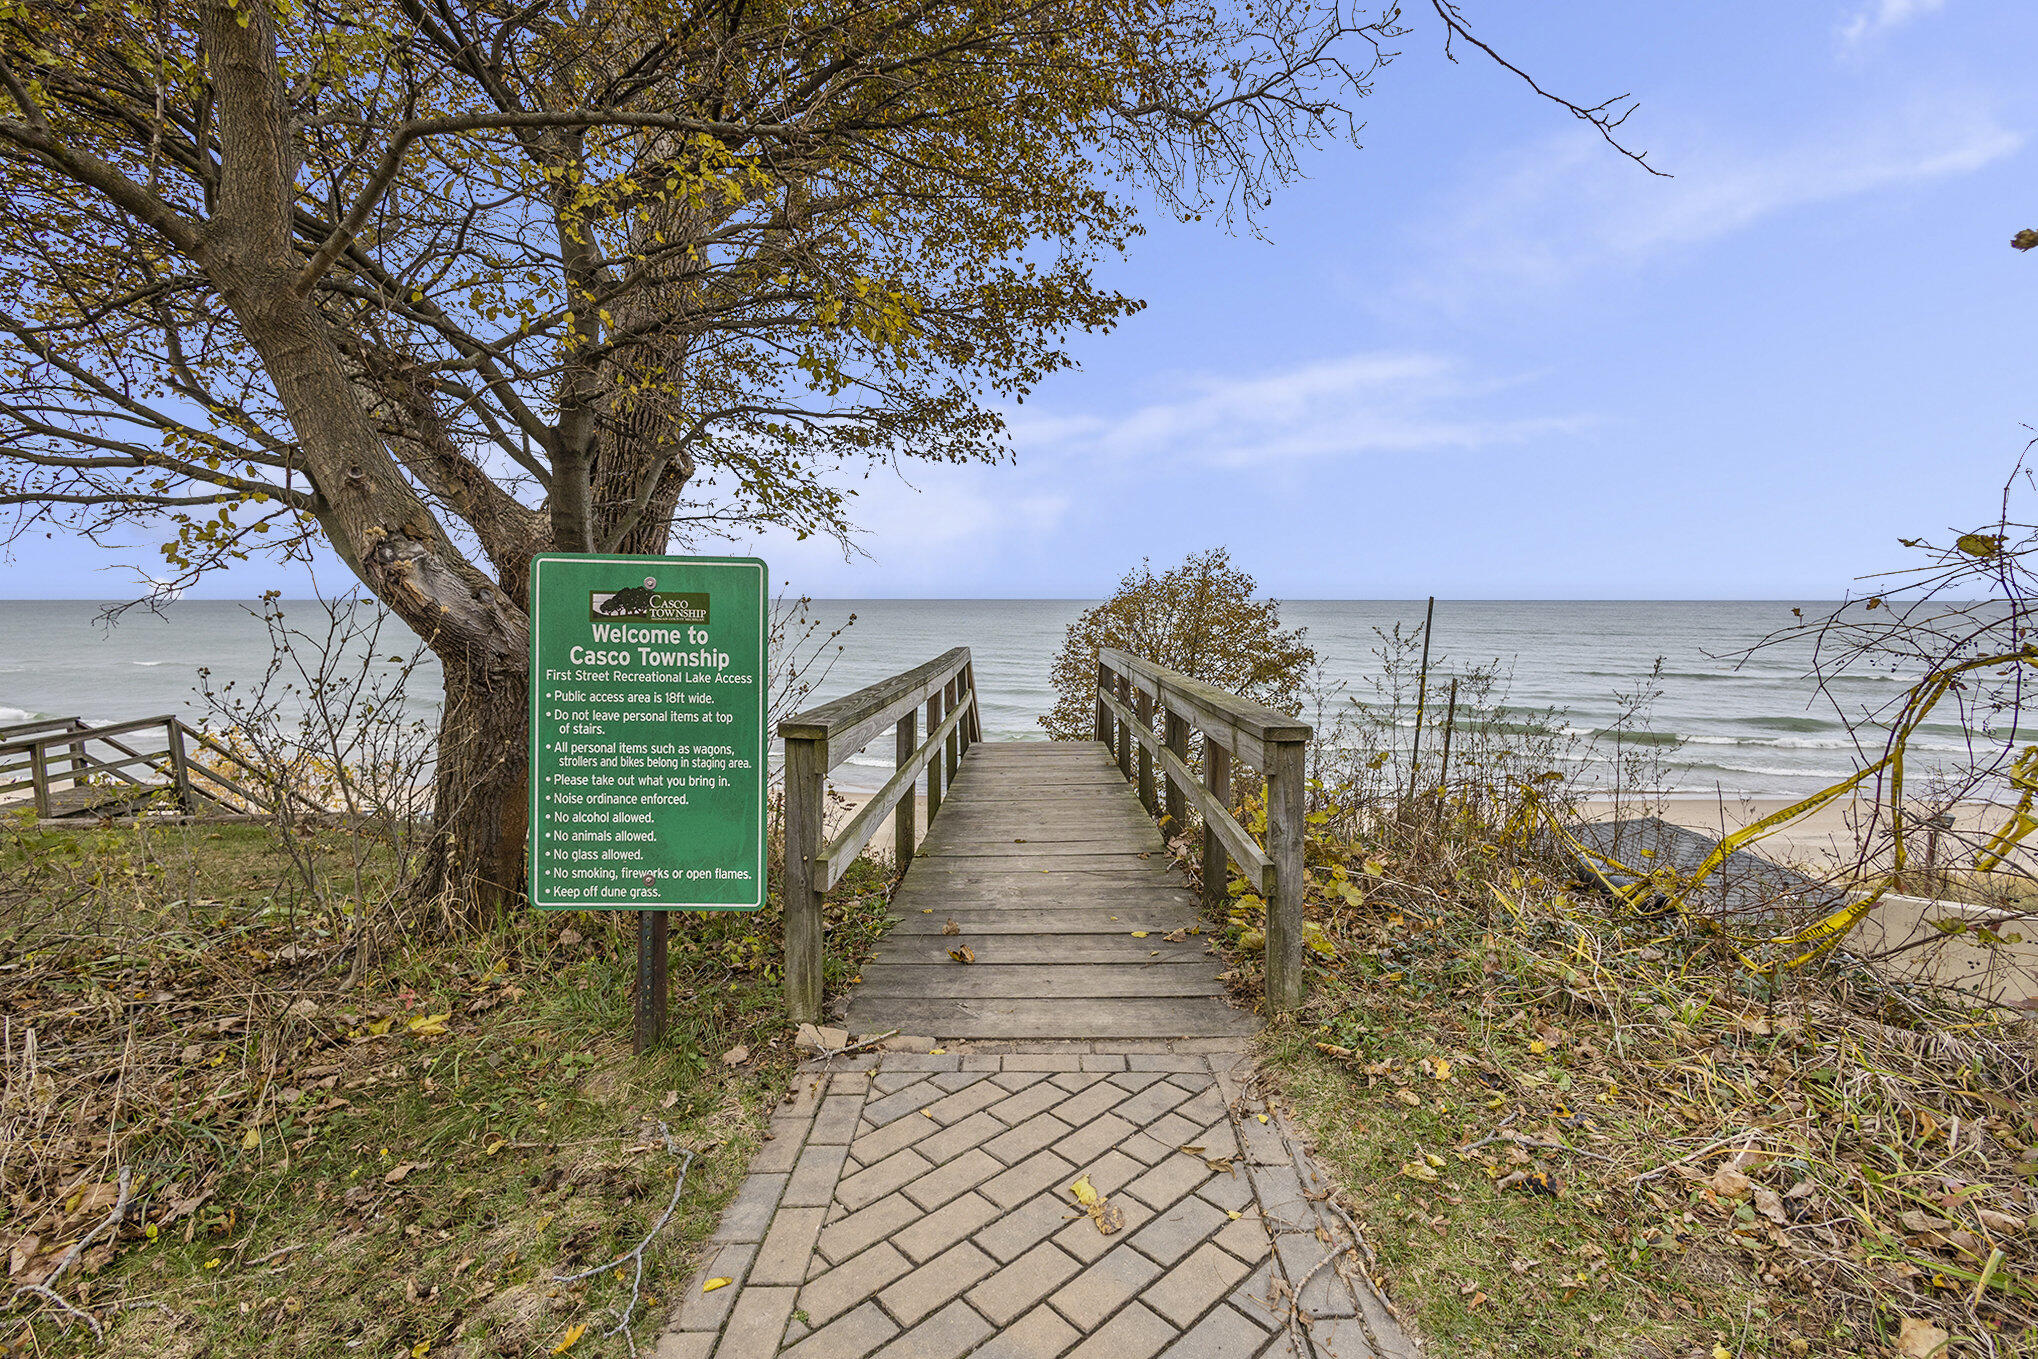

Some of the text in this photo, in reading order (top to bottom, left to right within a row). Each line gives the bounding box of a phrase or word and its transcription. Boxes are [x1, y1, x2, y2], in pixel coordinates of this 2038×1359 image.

[649, 608, 707, 618] TOWNSHIP
[592, 624, 708, 644] Welcome to
[570, 646, 730, 671] Casco Township
[547, 669, 752, 683] First Street Recreational Lake Access
[555, 690, 714, 703] Public access area is 18ft wide.
[555, 709, 733, 724] Do not leave personal items at top
[559, 723, 605, 734] of stairs.
[554, 742, 735, 757] All personal items such as wagons,
[559, 756, 751, 770] strollers and bikes belong in staging area.
[554, 774, 730, 789] Please take out what you bring in.
[554, 793, 688, 804] Noise ordinance enforced.
[555, 812, 654, 823] No alcohol allowed.
[554, 830, 656, 841] No animals allowed.
[554, 849, 643, 862] No glass allowed.
[554, 849, 751, 881] No smoking, fireworks or open flames.
[554, 867, 670, 899] Keep off dune grass.
